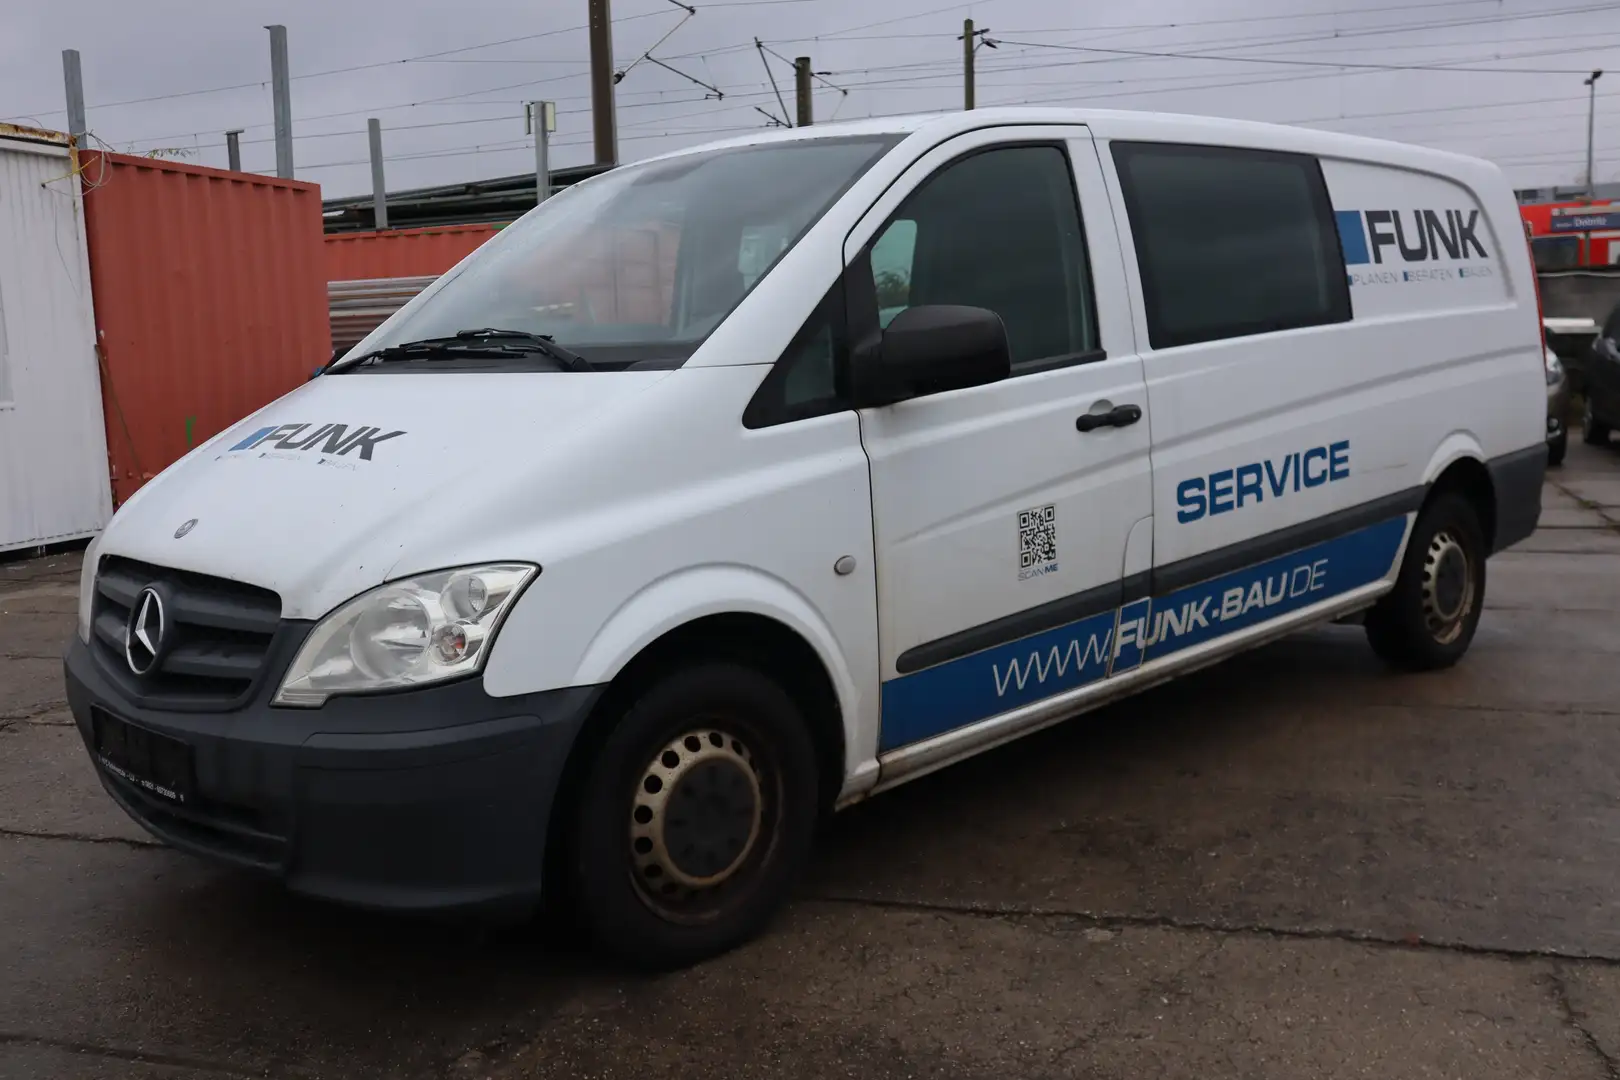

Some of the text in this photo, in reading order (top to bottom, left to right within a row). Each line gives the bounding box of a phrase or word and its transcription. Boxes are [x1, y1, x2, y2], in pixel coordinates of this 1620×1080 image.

[1364, 209, 1489, 264] FUNK
[1353, 272, 1398, 286] PLANEN
[248, 423, 408, 461] FUNK
[1177, 440, 1350, 524] SERVICE
